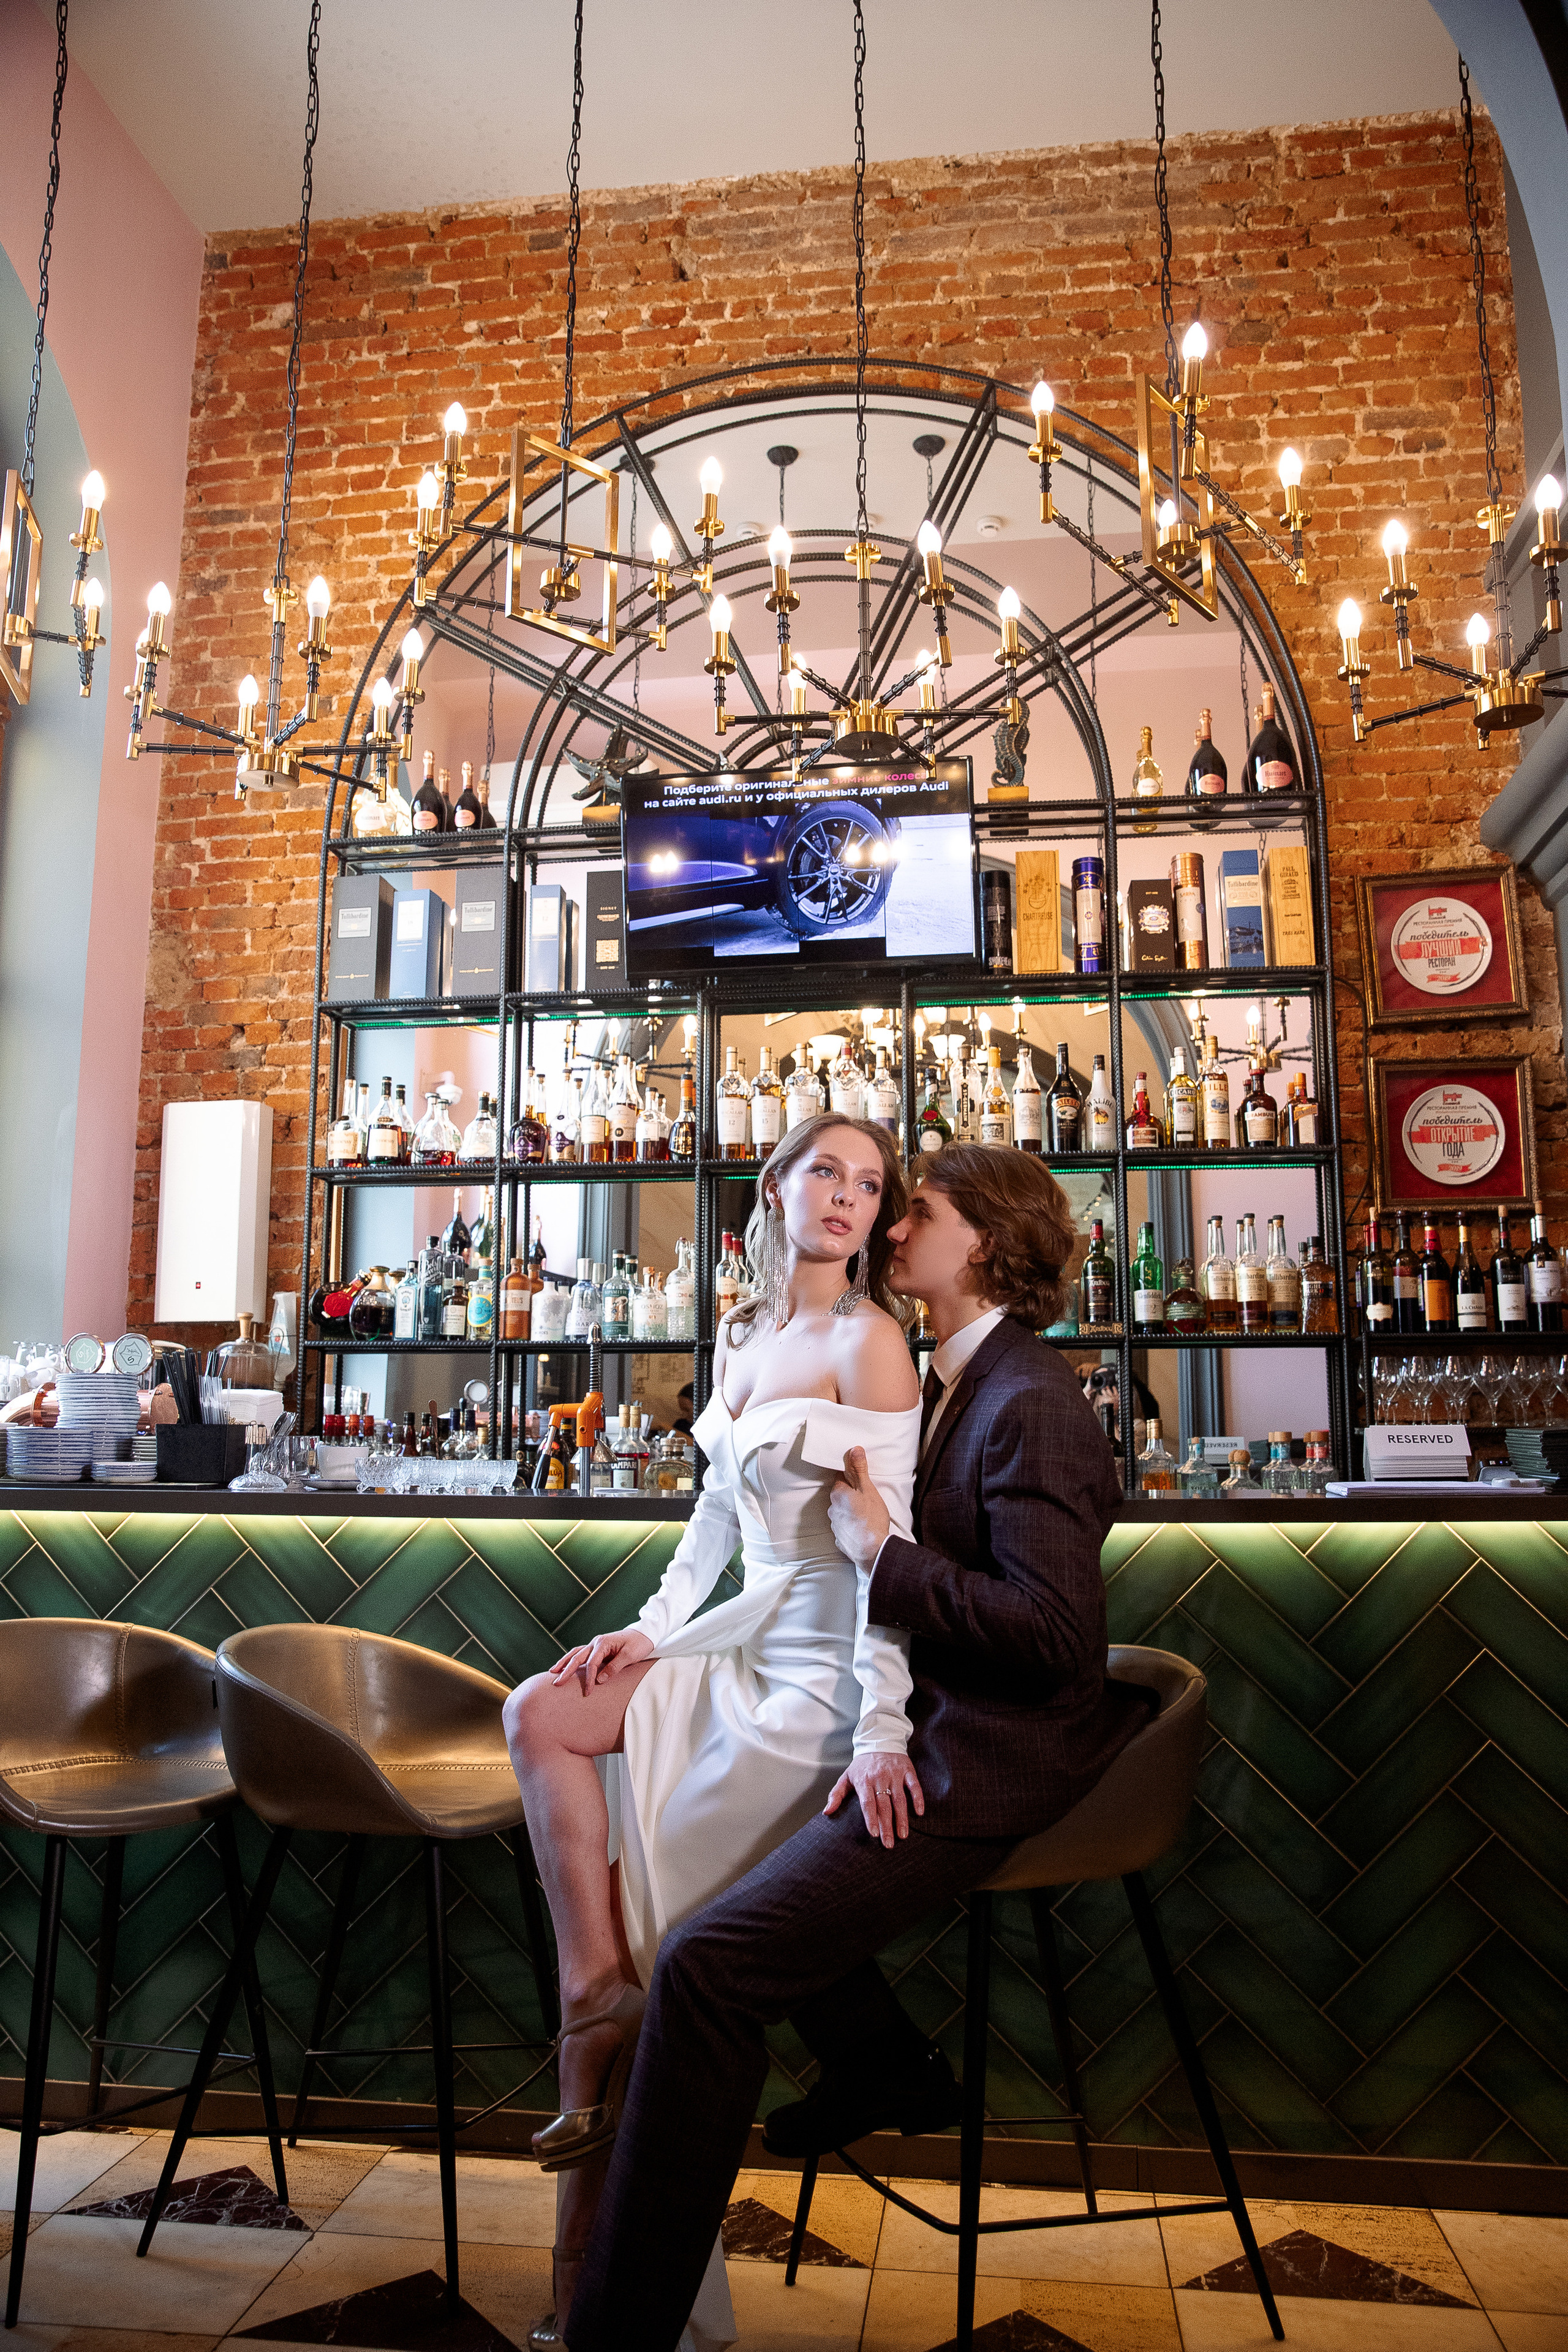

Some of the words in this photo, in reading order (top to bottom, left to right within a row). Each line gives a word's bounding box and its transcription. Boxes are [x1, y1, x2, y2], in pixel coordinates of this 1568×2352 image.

[664, 784, 732, 796] Подберите
[832, 774, 881, 785] зимние
[662, 796, 696, 807] сайте
[699, 794, 742, 805] audi.ru
[755, 794, 764, 803] у
[766, 788, 858, 802] официальных
[861, 784, 917, 796] дилеров
[919, 782, 949, 791] Audi
[1022, 911, 1053, 921] CHARTREUSE
[1410, 930, 1469, 941] победитель
[1428, 957, 1457, 968] РЕСТОРАН
[1422, 1115, 1483, 1125] победитель
[1430, 1126, 1474, 1142] ОТКРЫТИЕ
[1442, 1142, 1464, 1158] ГОДА
[1387, 1434, 1453, 1444] RESERVED
[611, 1460, 637, 1469] CAMPARI
